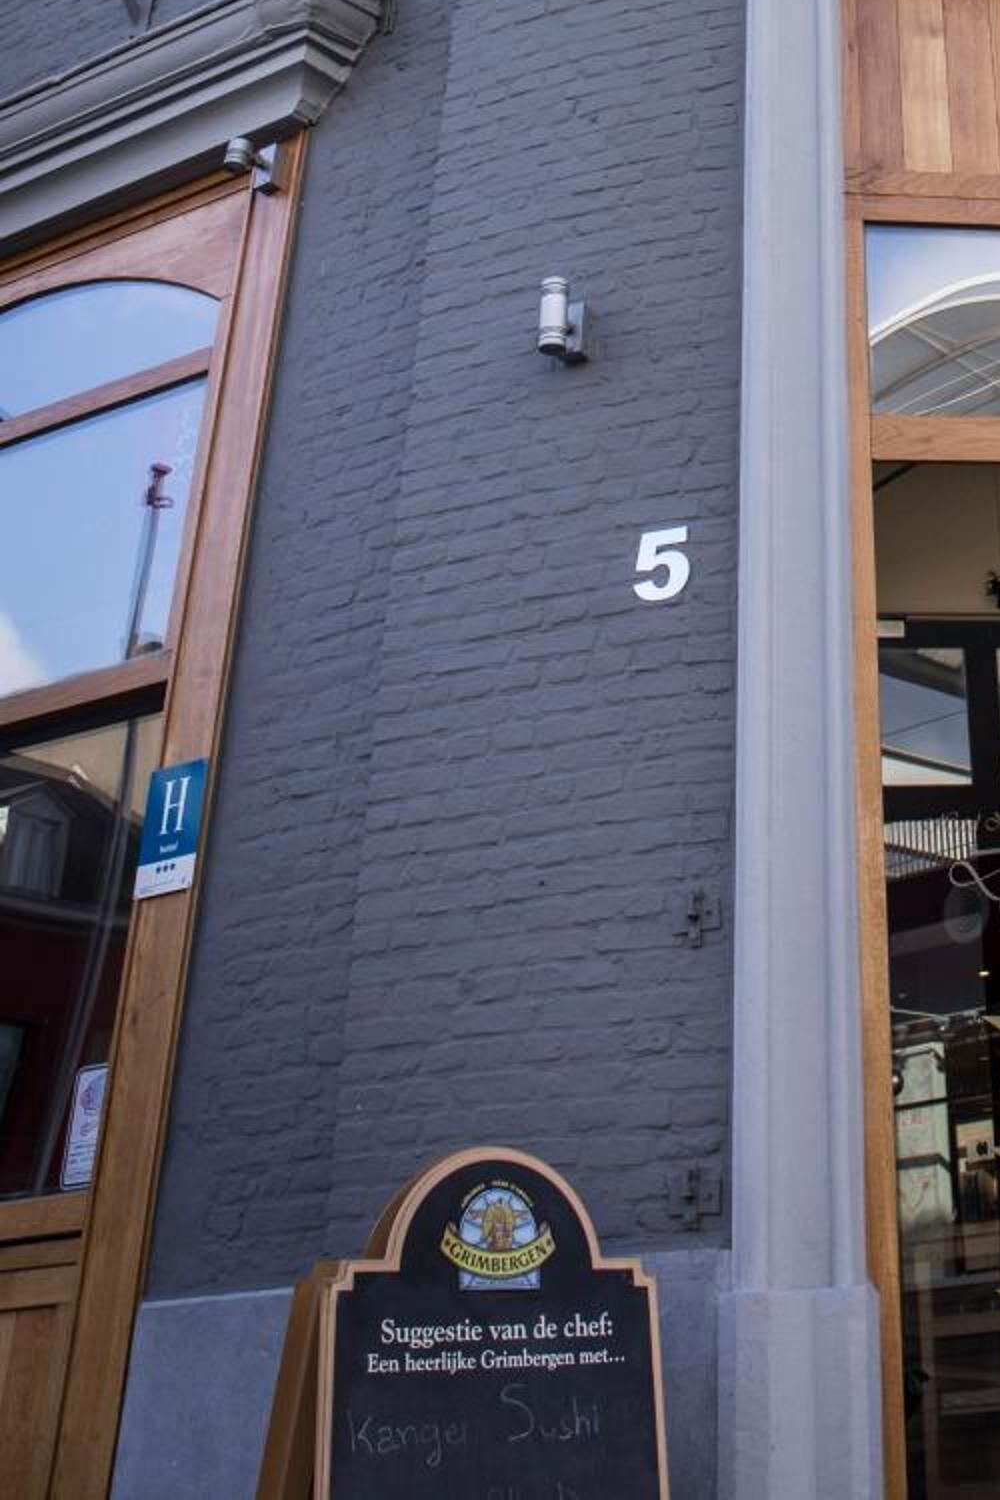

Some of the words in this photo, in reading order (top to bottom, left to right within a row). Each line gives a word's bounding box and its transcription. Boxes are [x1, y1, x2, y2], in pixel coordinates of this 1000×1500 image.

[633, 525, 691, 601] 5
[158, 775, 193, 837] H
[448, 1242, 547, 1273] GRIMBERGEN
[380, 1319, 483, 1348] Suggestie
[489, 1323, 529, 1340] van
[533, 1315, 558, 1339] de
[563, 1311, 614, 1337] chef:
[367, 1353, 400, 1373] Een
[405, 1351, 477, 1375] heerlijke
[481, 1348, 575, 1370] Grimbergen
